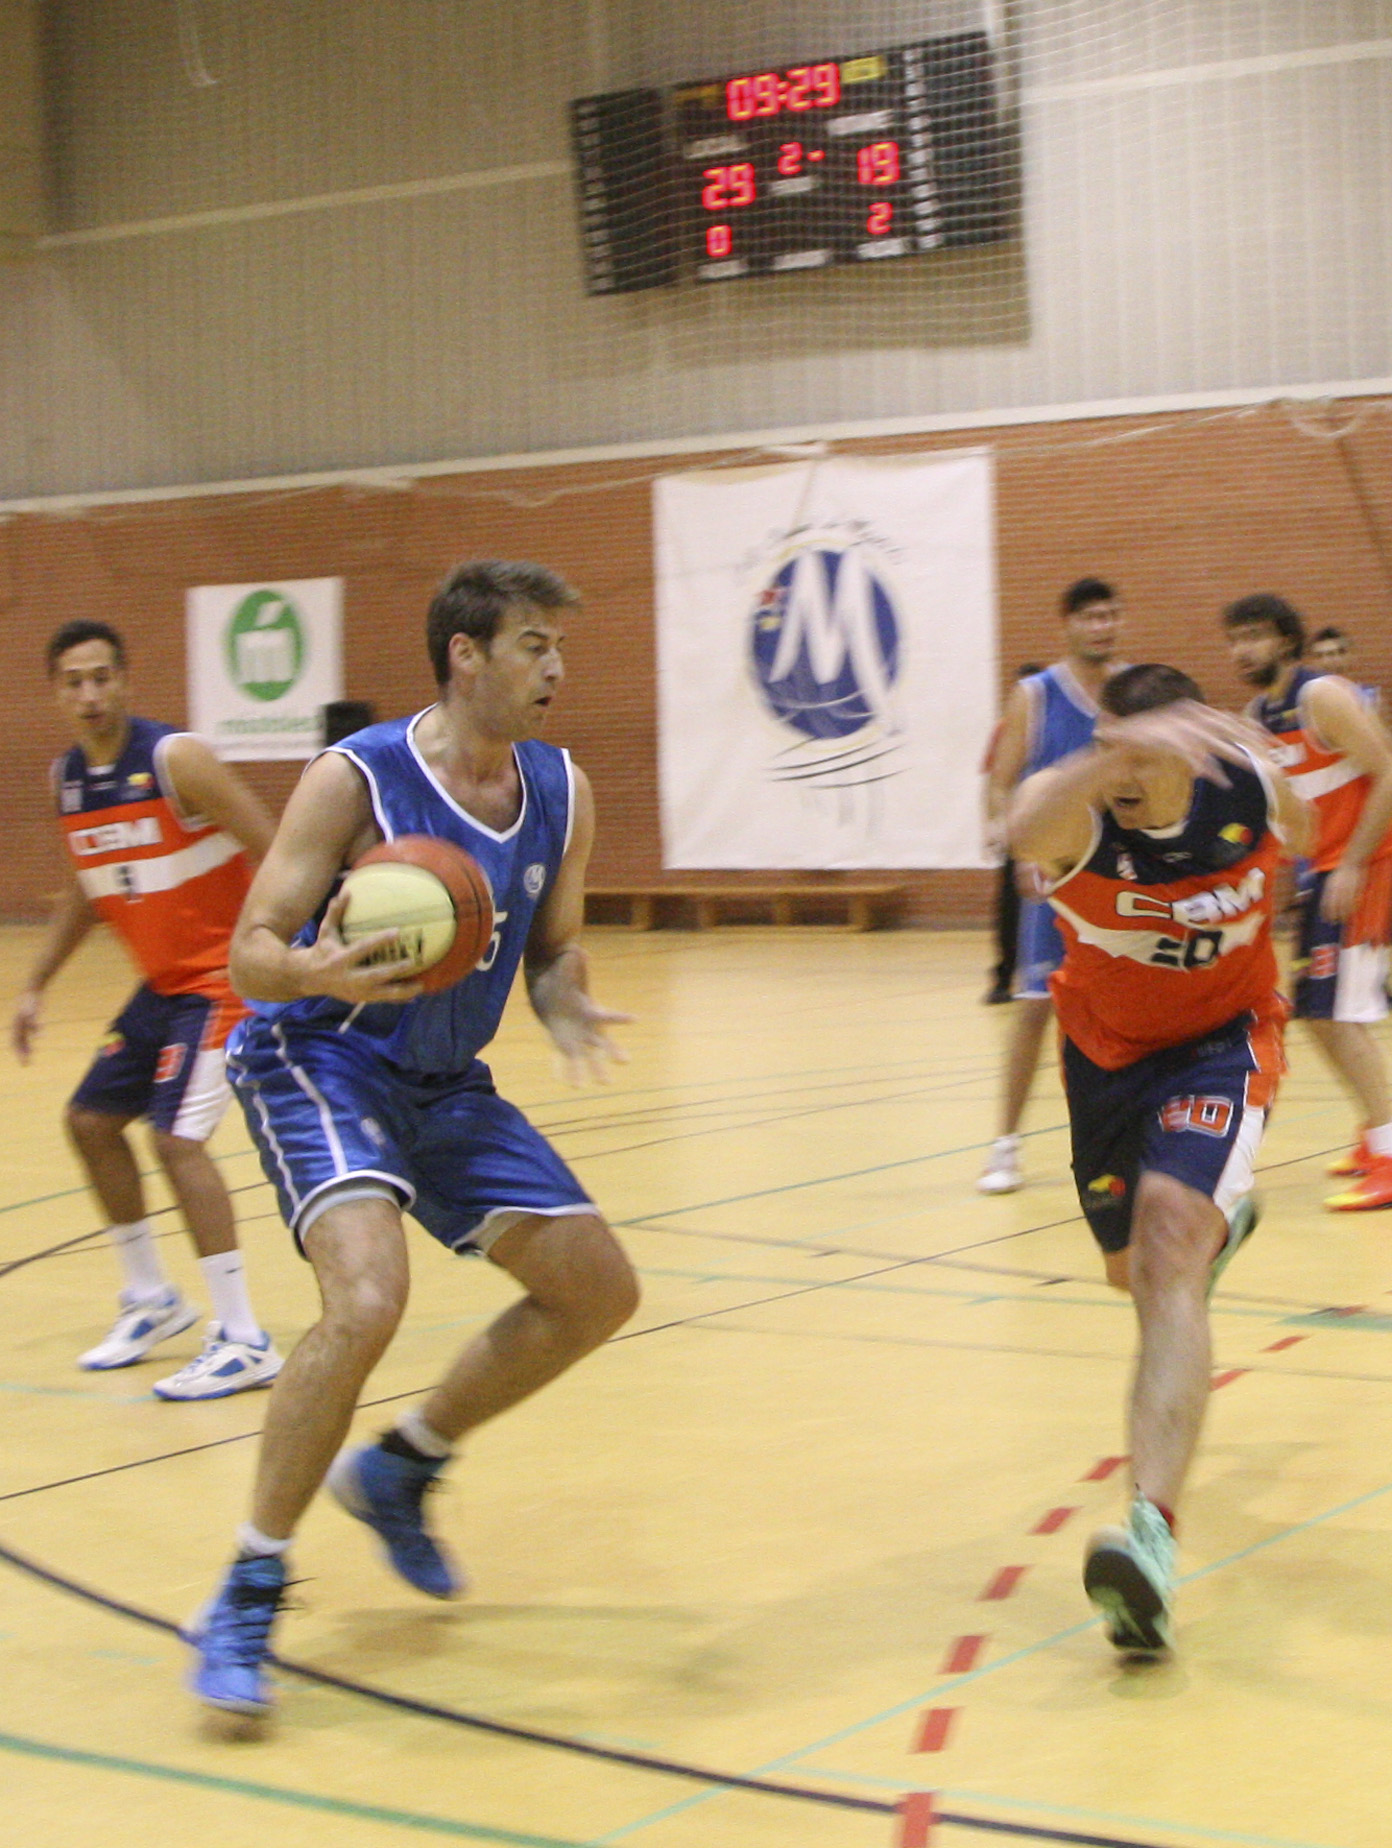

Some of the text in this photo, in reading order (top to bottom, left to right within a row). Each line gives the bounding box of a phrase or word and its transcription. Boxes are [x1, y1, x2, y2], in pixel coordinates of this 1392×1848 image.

[726, 62, 841, 121] 09:29
[777, 142, 803, 175] 2
[857, 142, 900, 186] 19
[701, 162, 756, 211] 29
[865, 201, 893, 236] 2
[704, 223, 733, 258] 0
